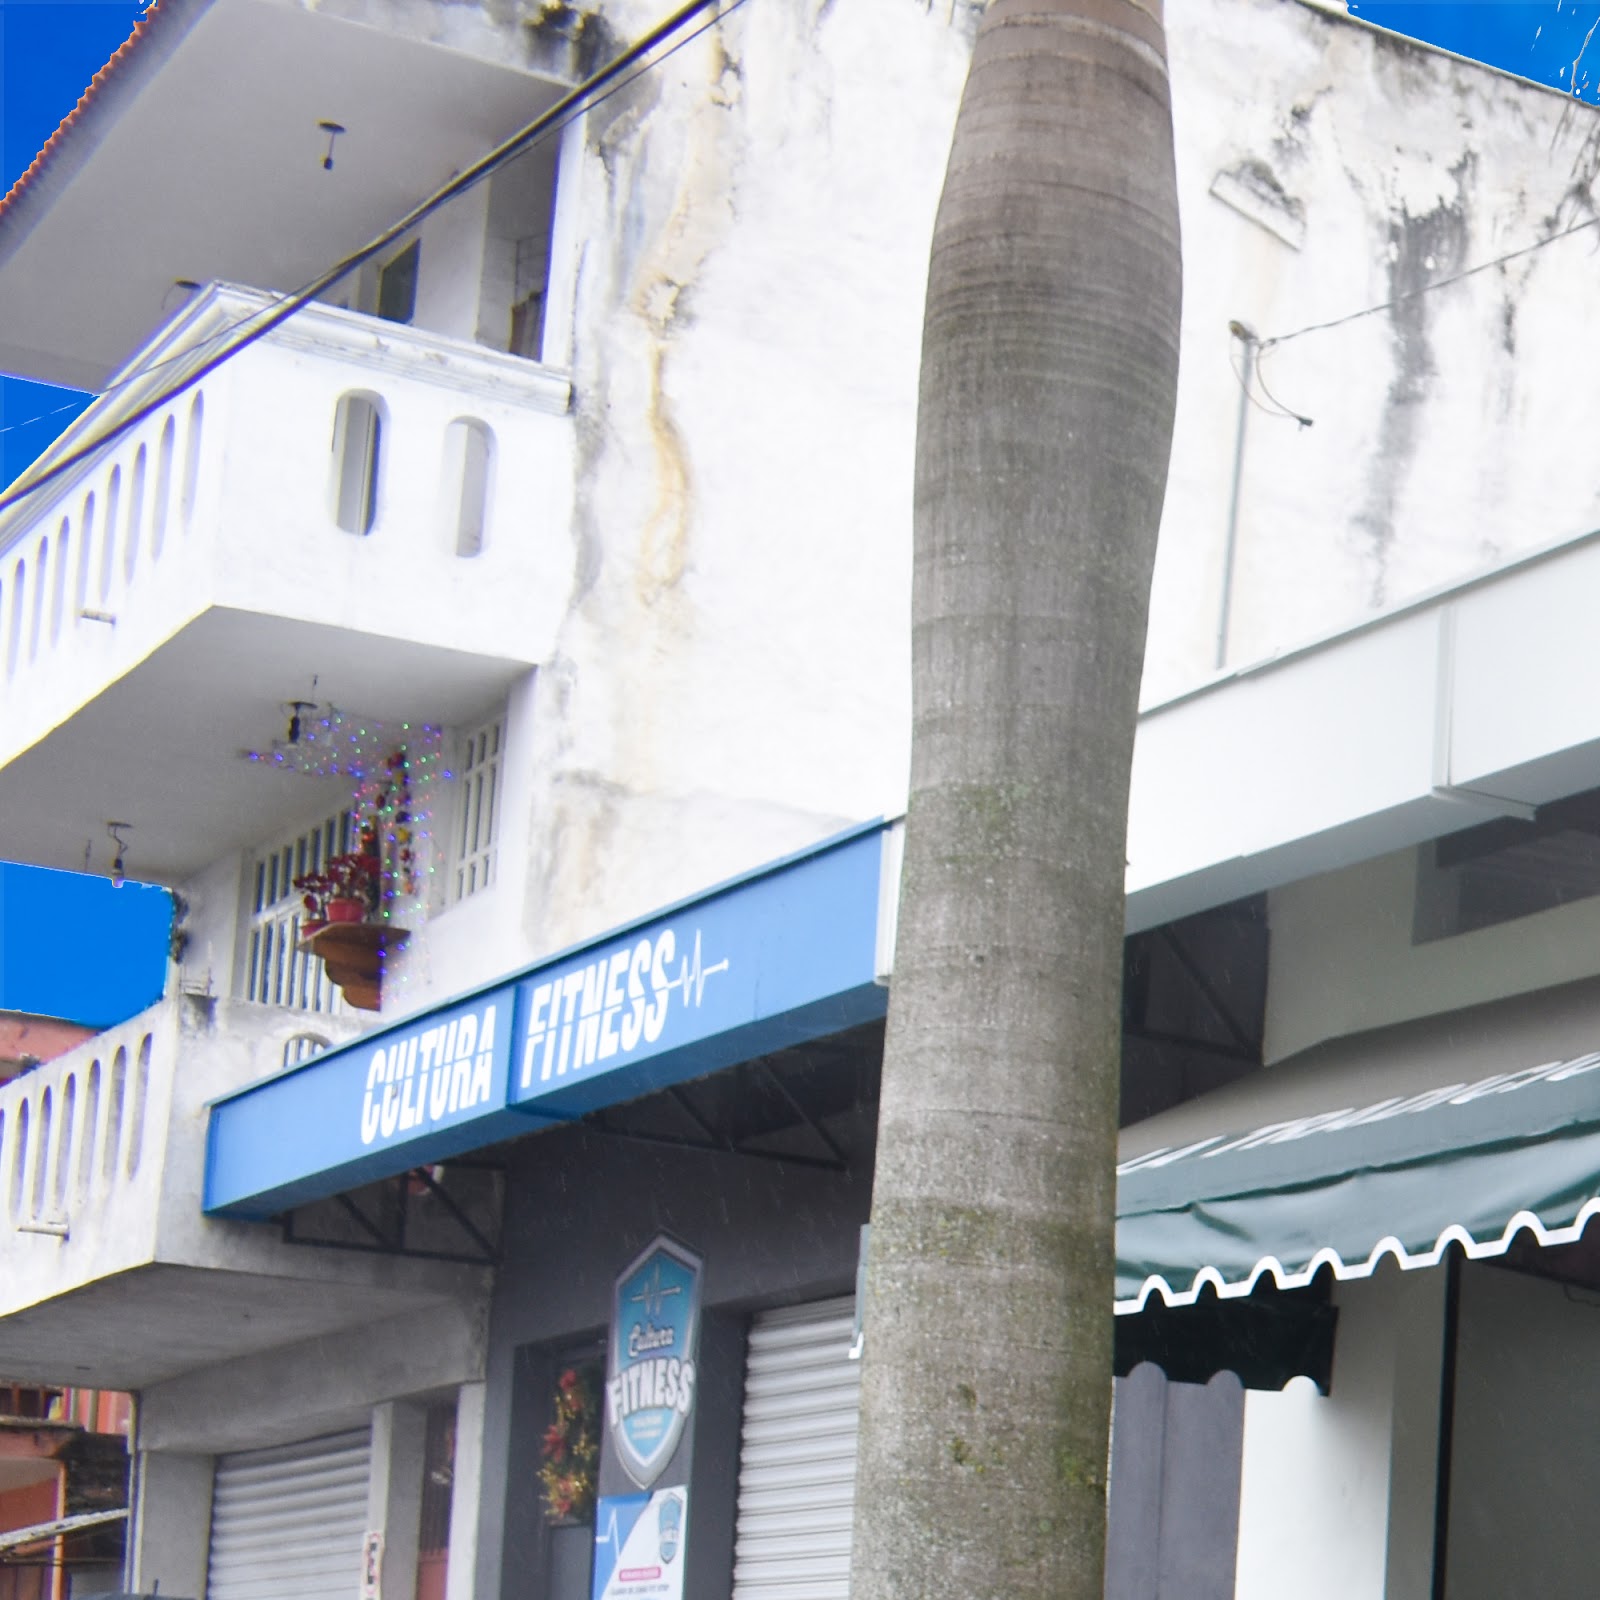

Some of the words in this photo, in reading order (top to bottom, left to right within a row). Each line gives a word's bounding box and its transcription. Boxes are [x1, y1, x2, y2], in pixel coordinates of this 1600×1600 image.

[520, 928, 677, 1089] FITNESS
[359, 1004, 497, 1145] CULTURA
[607, 1357, 696, 1427] FITNESS
[628, 1322, 675, 1357] Cultura
